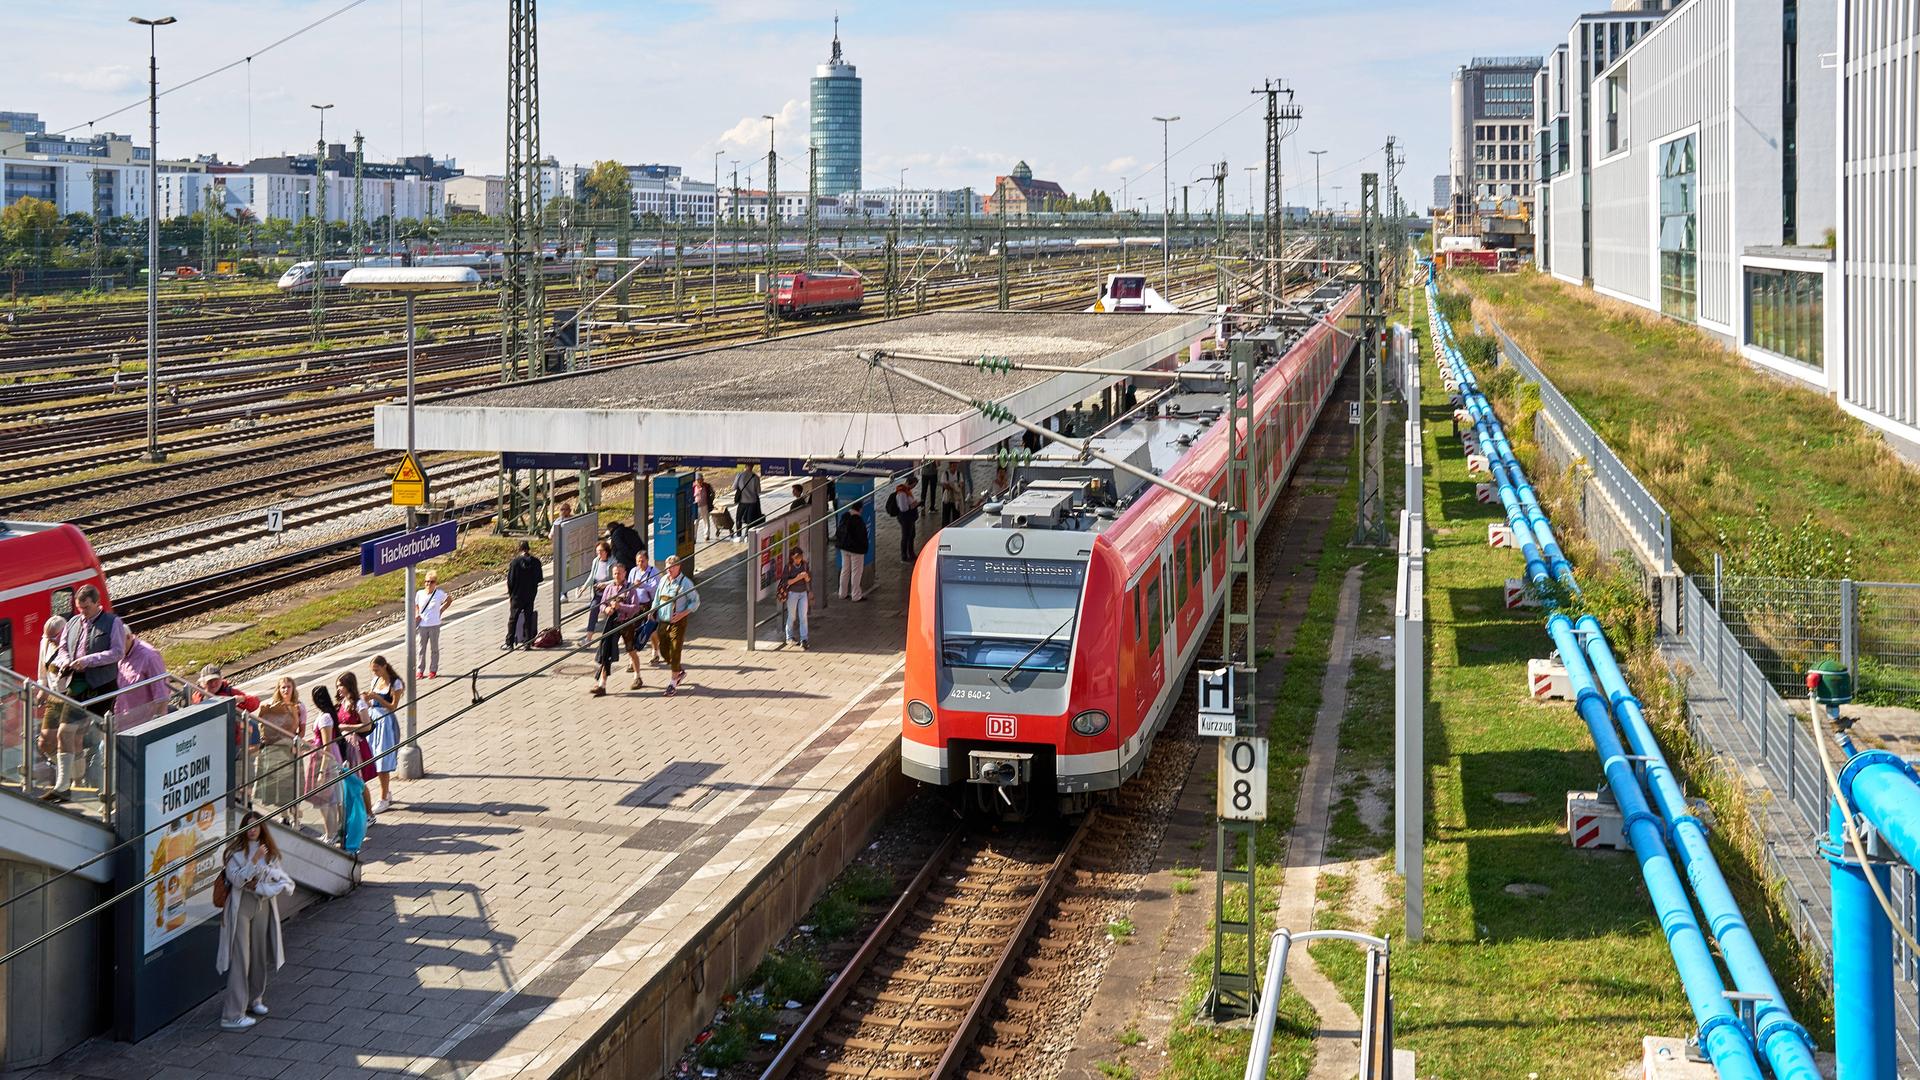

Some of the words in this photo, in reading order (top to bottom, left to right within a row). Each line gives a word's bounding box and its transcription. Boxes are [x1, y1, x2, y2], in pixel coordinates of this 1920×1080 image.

[1351, 403, 1359, 416] H
[272, 512, 279, 529] 7
[381, 532, 441, 565] Hackerbrücke
[985, 562, 1073, 576] Petershausen
[951, 689, 966, 699] 423
[1203, 666, 1230, 708] H
[990, 719, 1013, 734] DB
[1201, 717, 1233, 734] Kurzzug
[162, 763, 189, 791] ALLES
[190, 754, 211, 779] DRIN
[162, 786, 181, 815] FÜR
[183, 775, 210, 806] DICH!
